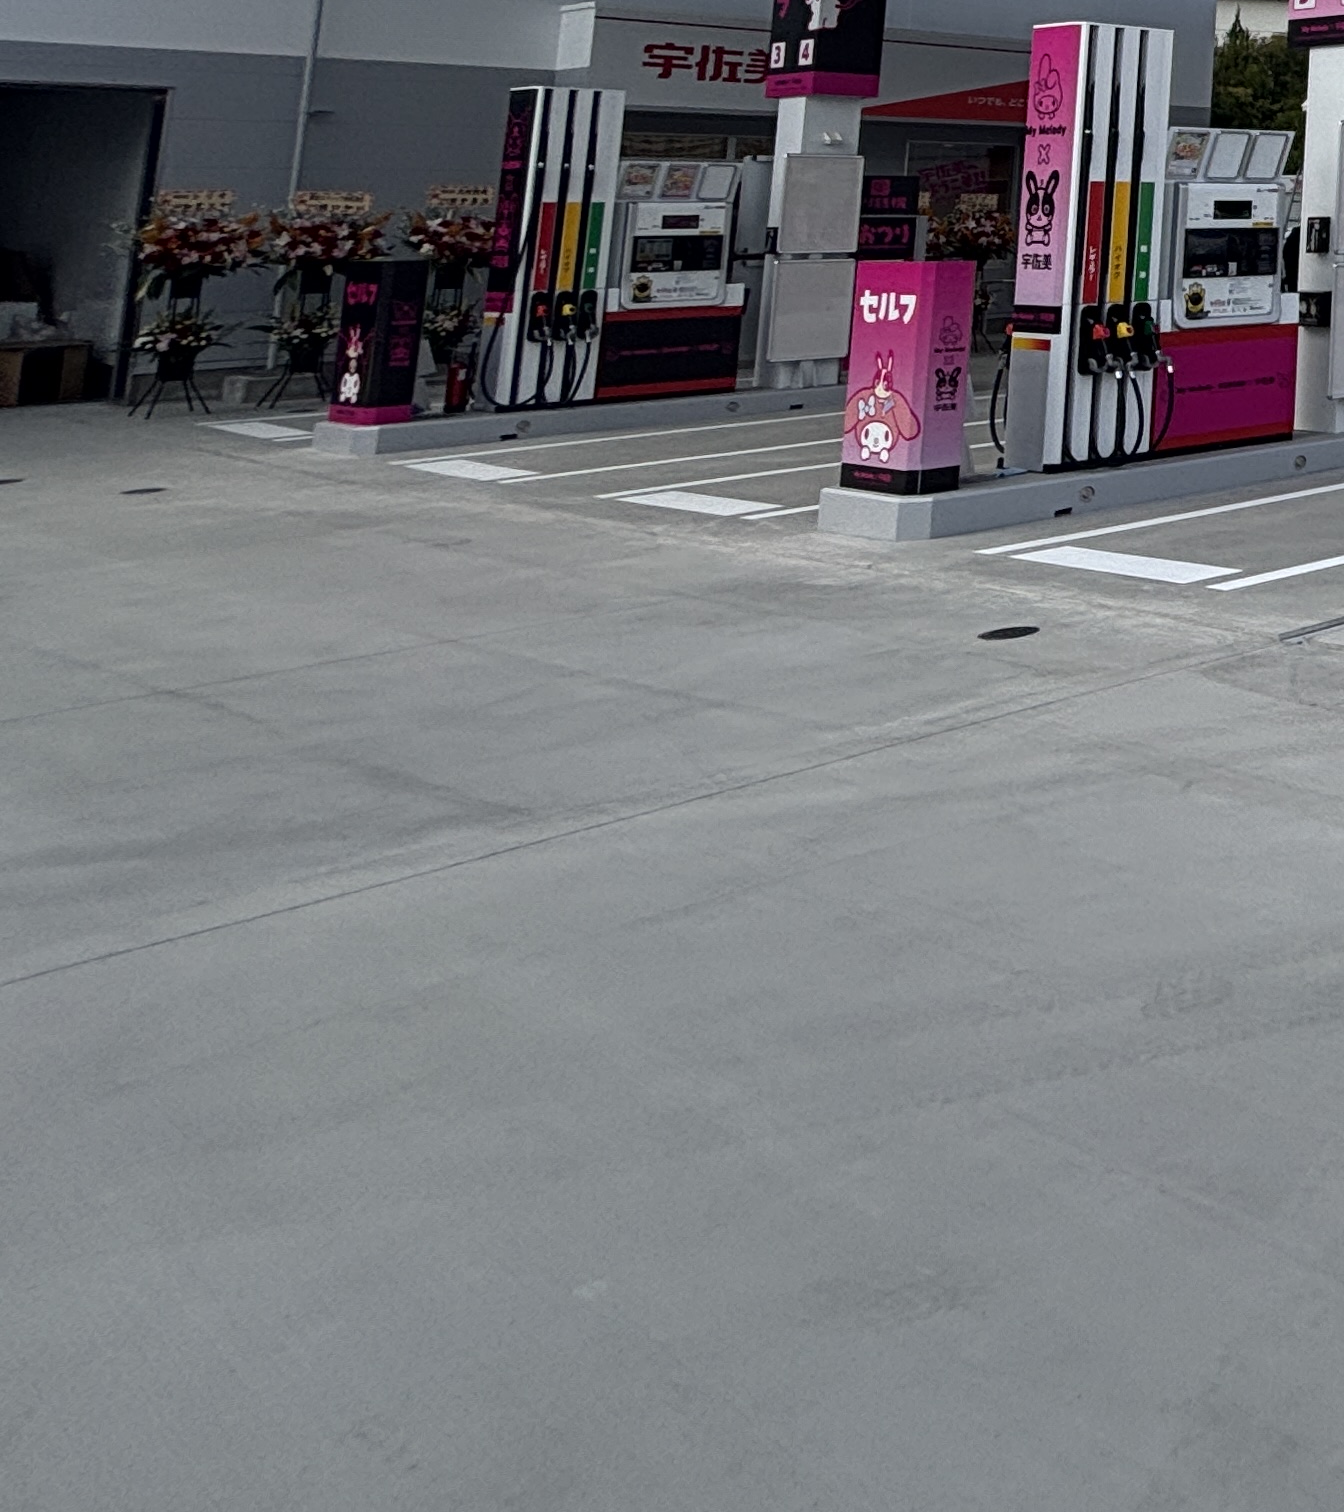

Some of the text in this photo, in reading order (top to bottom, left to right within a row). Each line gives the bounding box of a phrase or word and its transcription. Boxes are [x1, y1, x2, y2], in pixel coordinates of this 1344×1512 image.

[773, 42, 810, 65] 3 4
[1039, 124, 1067, 136] Melody
[860, 223, 910, 244] おつり
[1021, 253, 1052, 270] 宇佐美
[859, 289, 917, 325] セルフ
